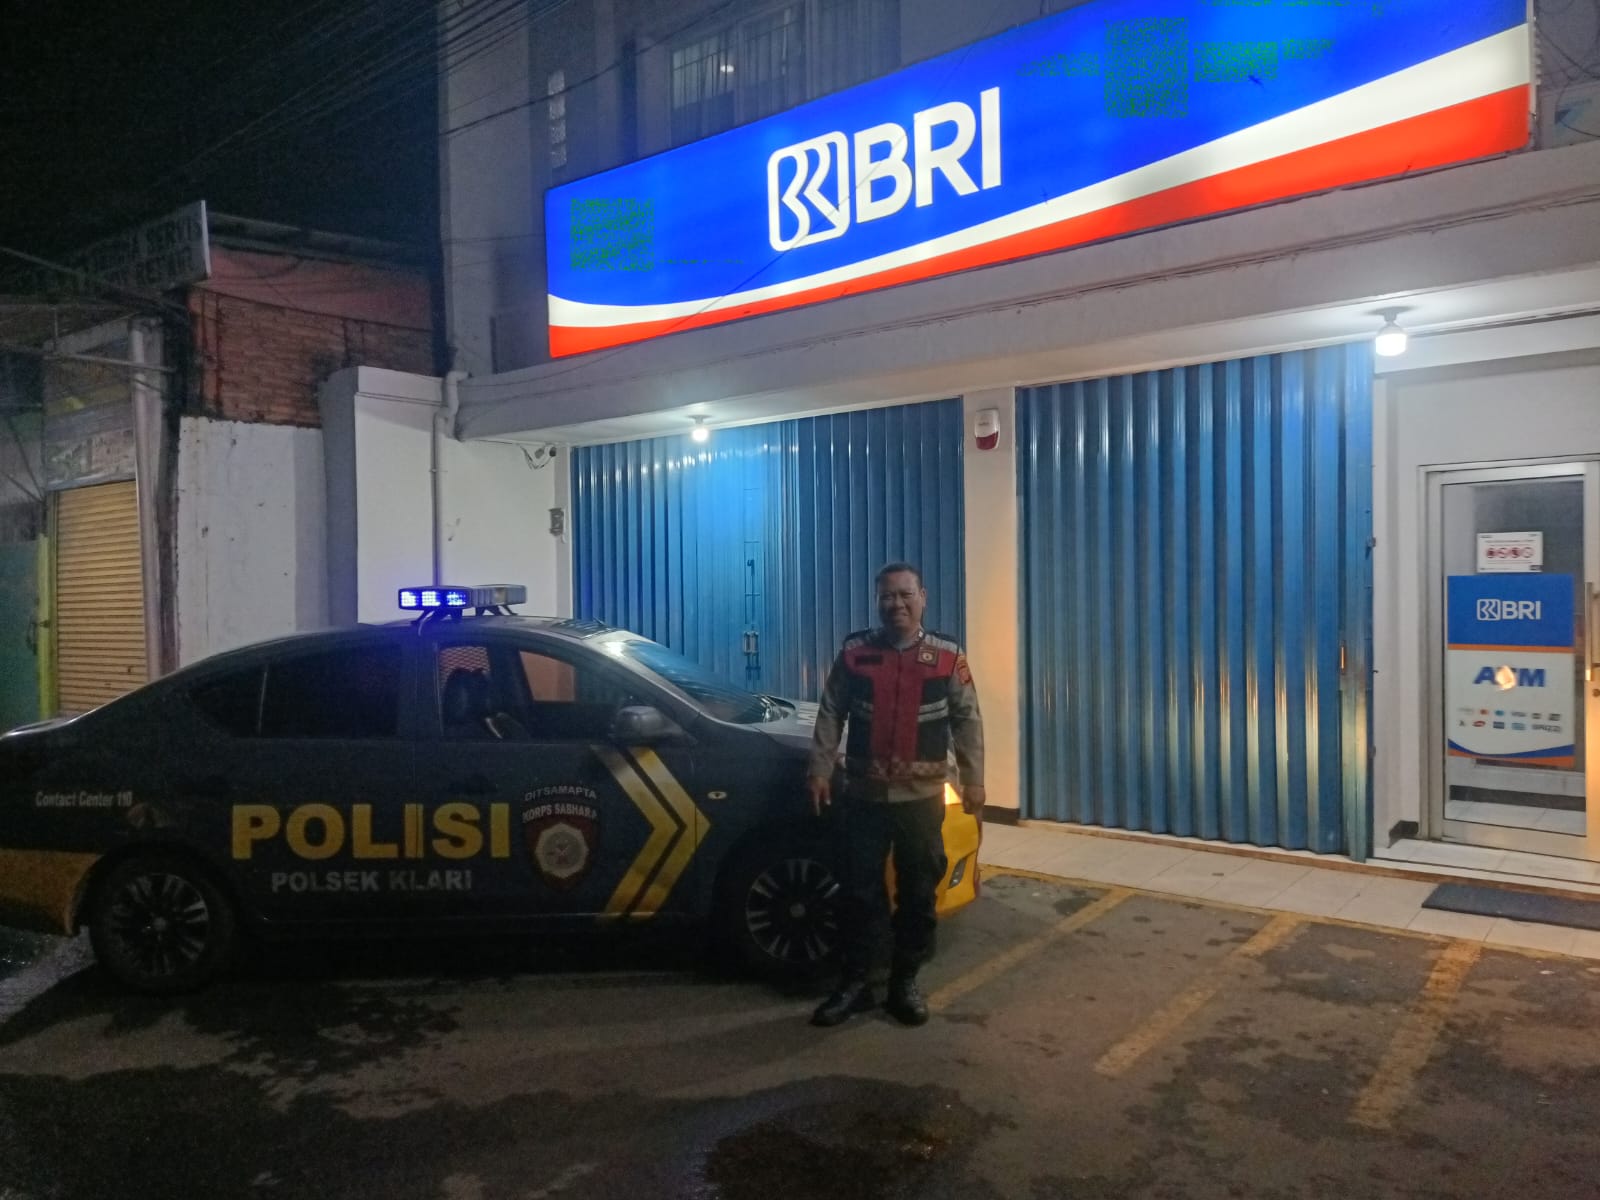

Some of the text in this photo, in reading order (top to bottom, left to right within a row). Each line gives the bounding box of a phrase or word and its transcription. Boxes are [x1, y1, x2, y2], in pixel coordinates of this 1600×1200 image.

[854, 87, 1001, 223] BRI
[1501, 600, 1541, 620] BRI
[1473, 667, 1545, 687] AM
[35, 790, 76, 807] Contact
[78, 790, 114, 807] Center
[524, 785, 597, 801] DITSAMAPTA
[522, 803, 598, 824] KORPS SABHARA
[230, 802, 512, 861] POLISI
[271, 869, 473, 893] POLSEK KLARI
